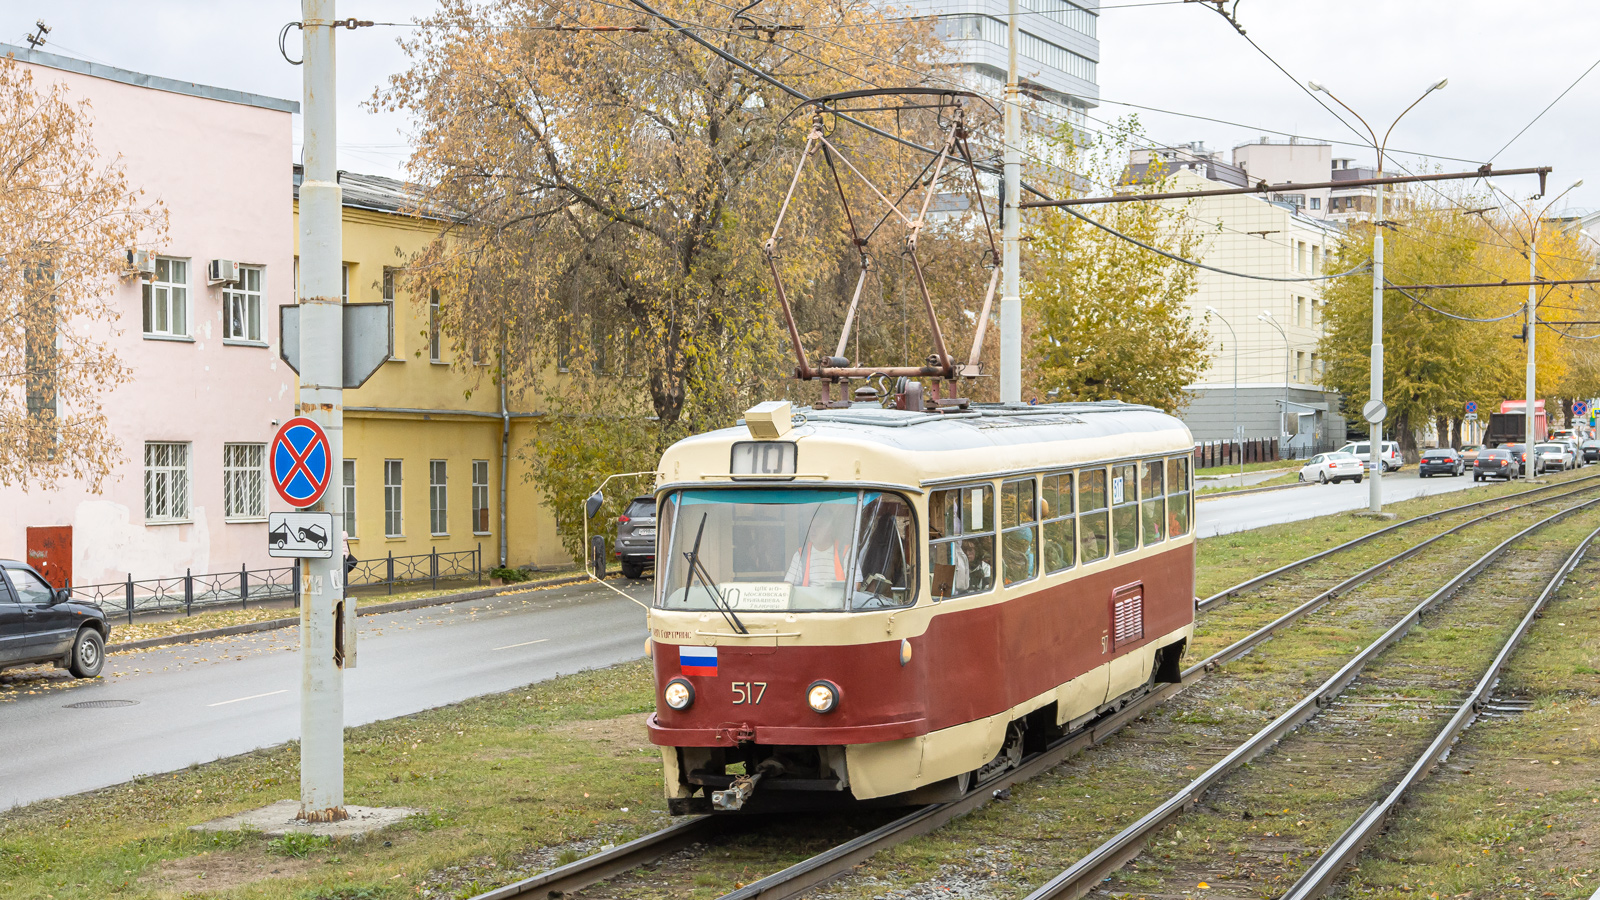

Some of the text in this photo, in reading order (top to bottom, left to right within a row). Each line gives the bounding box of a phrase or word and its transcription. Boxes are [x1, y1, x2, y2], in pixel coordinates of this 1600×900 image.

[747, 444, 784, 474] 10
[720, 587, 741, 609] 10
[731, 681, 768, 705] 517
